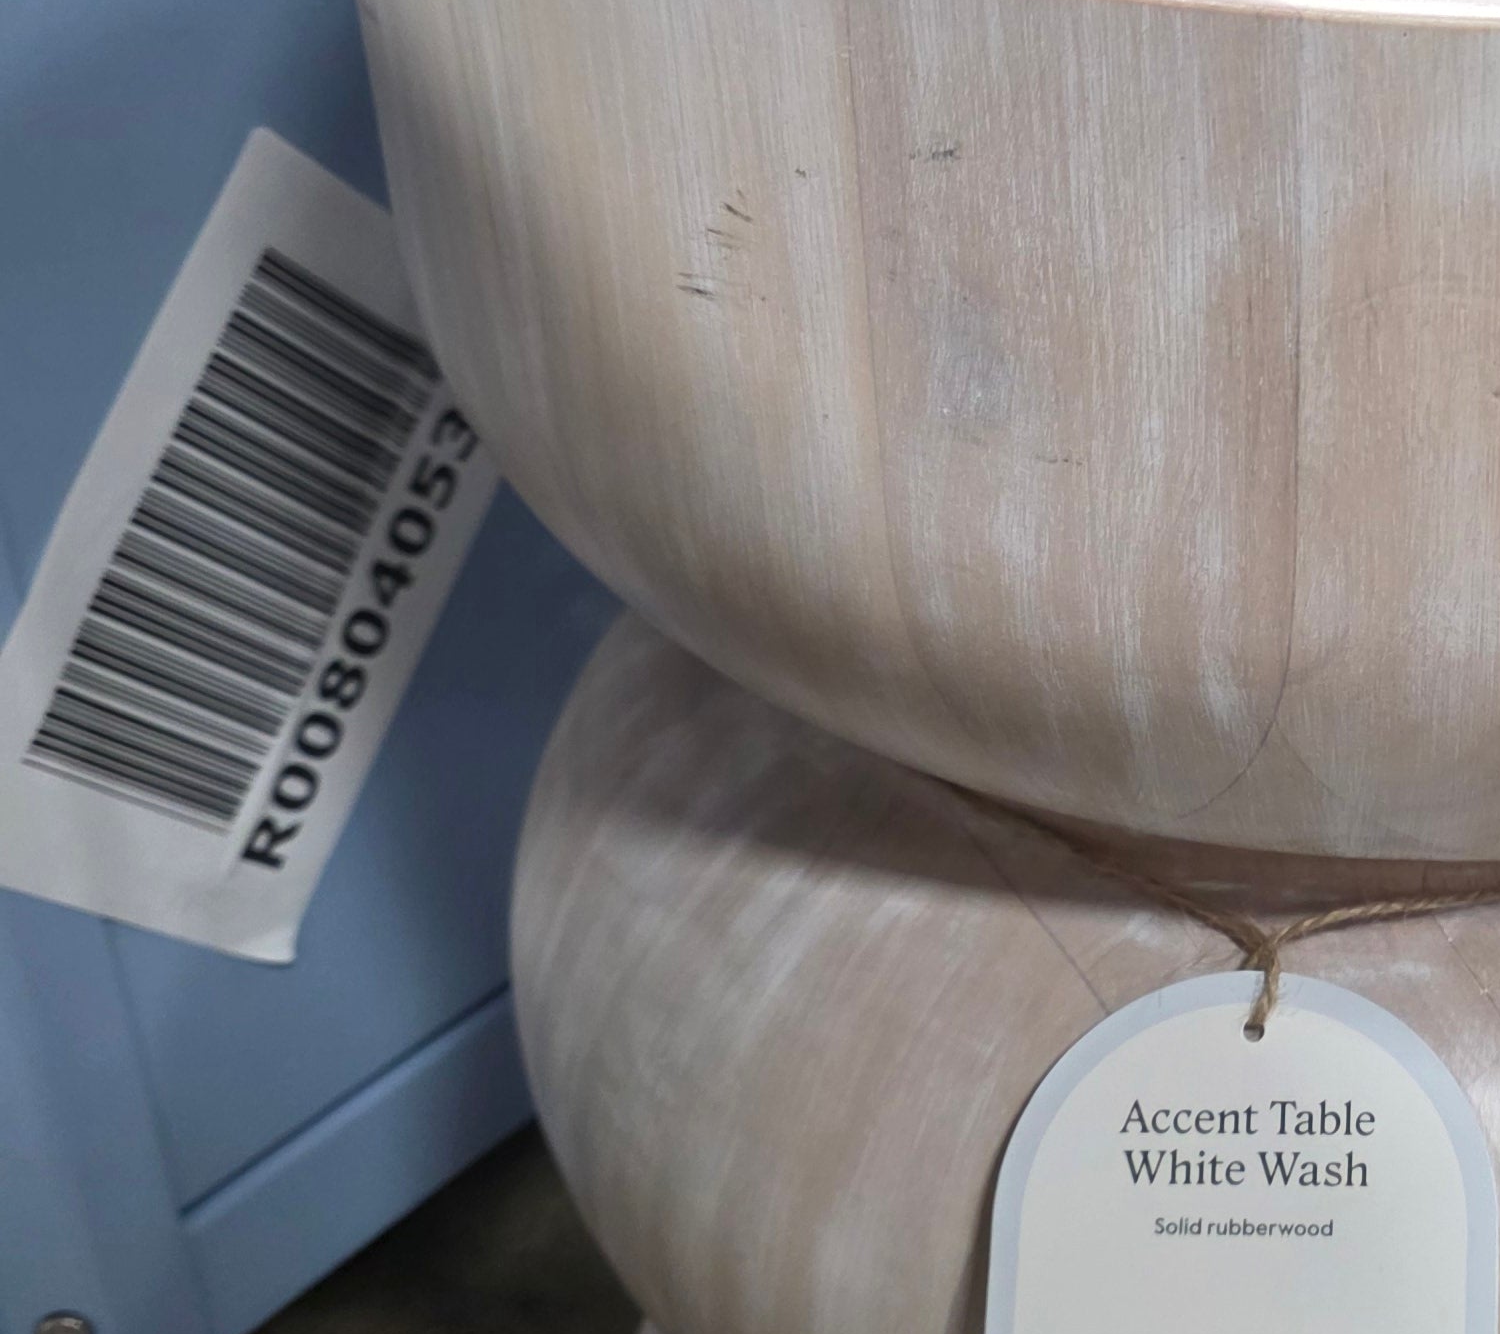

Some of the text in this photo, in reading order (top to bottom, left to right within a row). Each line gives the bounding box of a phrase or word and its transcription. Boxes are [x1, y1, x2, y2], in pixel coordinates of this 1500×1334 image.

[241, 407, 479, 869] R00804053
[1118, 1098, 1376, 1137] Accent Table
[1122, 1149, 1369, 1188] White Wash
[1153, 1216, 1334, 1238] Solid rubberwood
